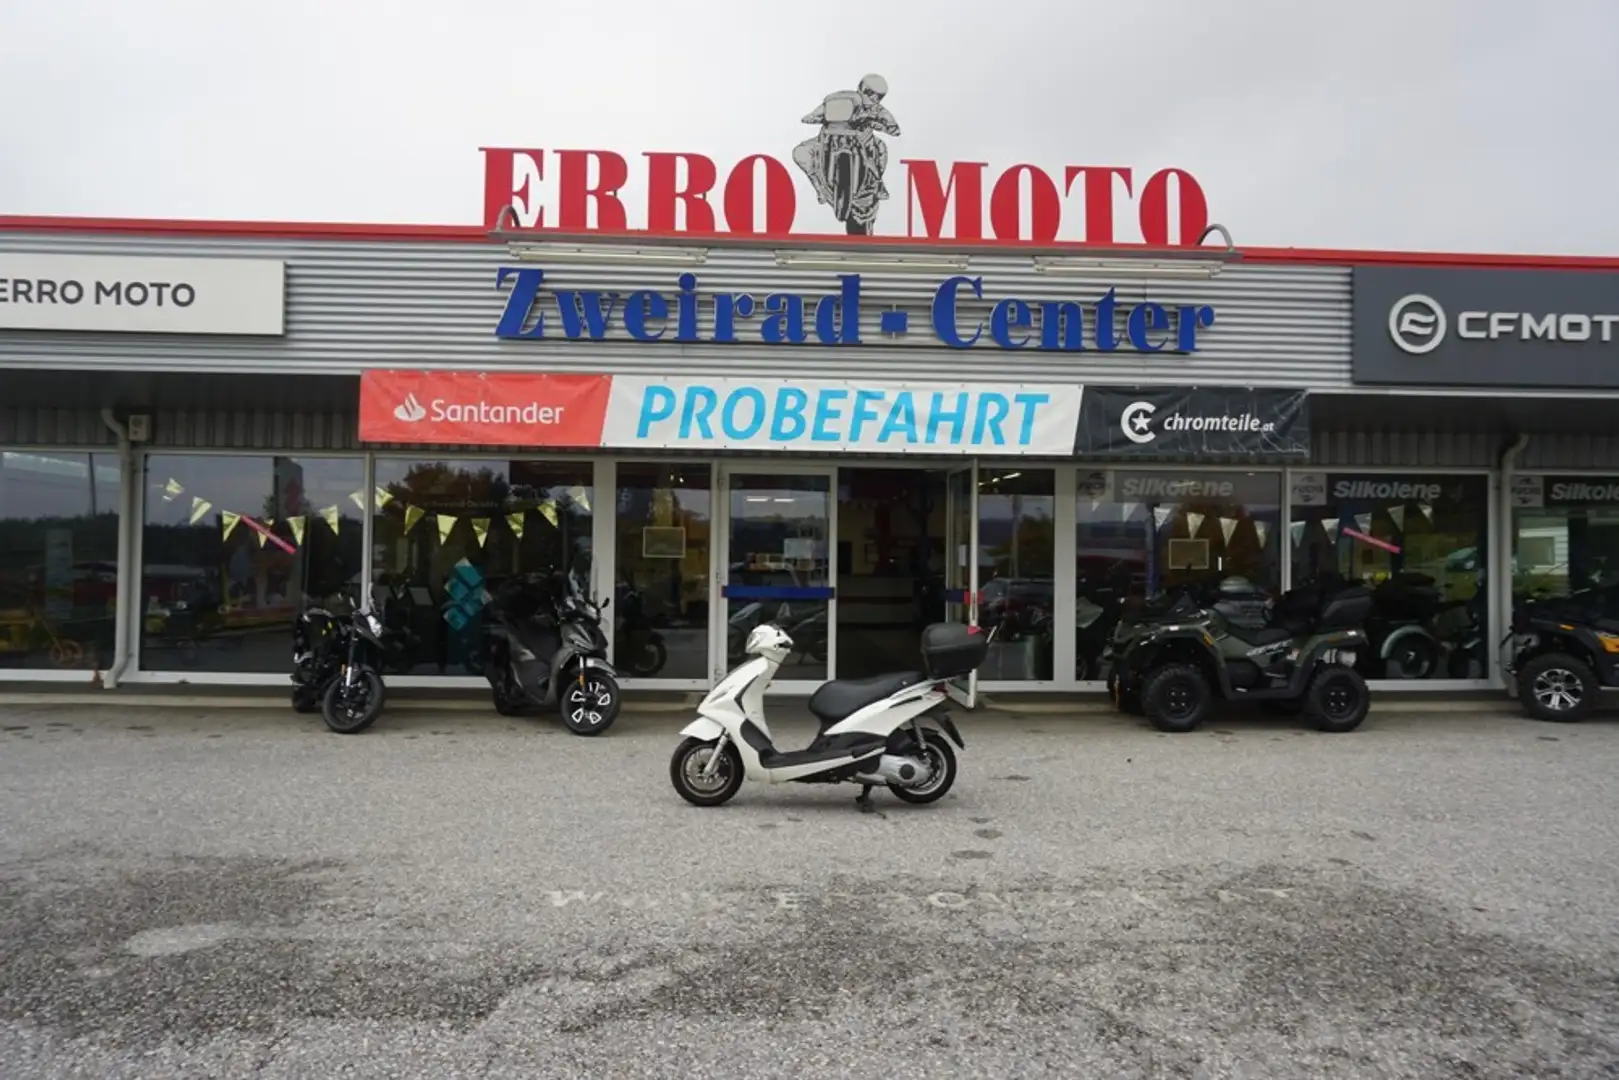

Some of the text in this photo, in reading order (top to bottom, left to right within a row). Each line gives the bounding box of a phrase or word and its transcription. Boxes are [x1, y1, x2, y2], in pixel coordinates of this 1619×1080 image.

[478, 146, 1208, 247] ERRO MOTO
[95, 281, 196, 308] MOTO
[494, 266, 862, 345] Zweirad
[931, 275, 1216, 352] Center
[430, 399, 565, 425] Santander
[636, 384, 1050, 446] PROBEFAHRT
[1121, 476, 1234, 498] Silkolene
[1333, 479, 1442, 500] Silkolene
